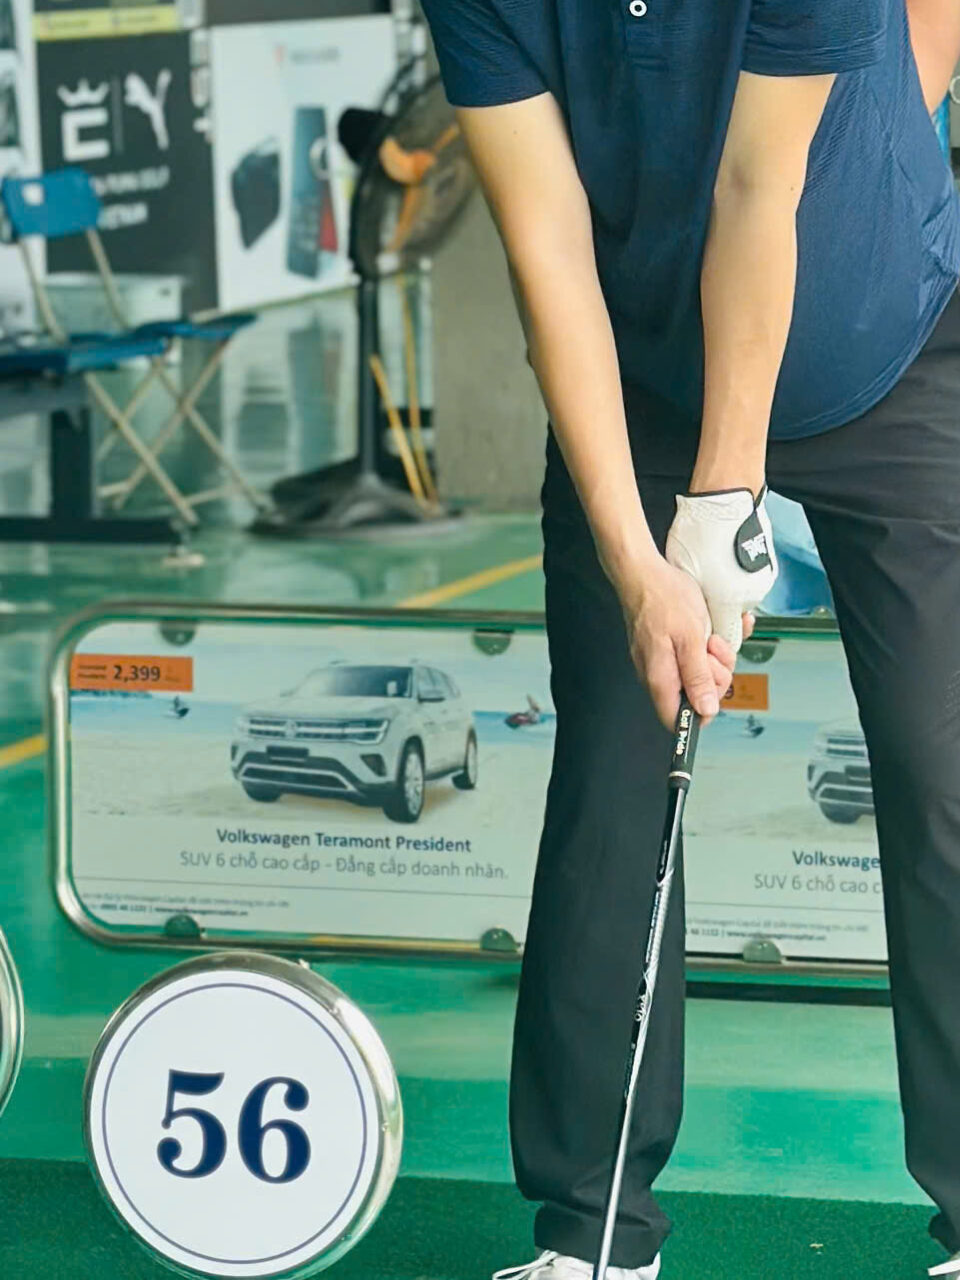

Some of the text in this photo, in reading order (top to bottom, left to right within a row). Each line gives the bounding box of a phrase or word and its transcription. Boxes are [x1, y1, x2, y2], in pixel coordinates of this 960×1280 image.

[113, 664, 160, 682] 2,399
[217, 828, 471, 853] Volkswagen Teramont President
[180, 851, 211, 867] SUV
[216, 852, 226, 868] 6
[230, 851, 258, 871] chỗ
[262, 856, 289, 871] cao
[411, 861, 460, 877] doanh
[754, 874, 787, 890] SUV
[791, 876, 802, 890] 6
[806, 874, 836, 892] chỗ
[840, 880, 869, 894] cao
[157, 1069, 311, 1184] 56
